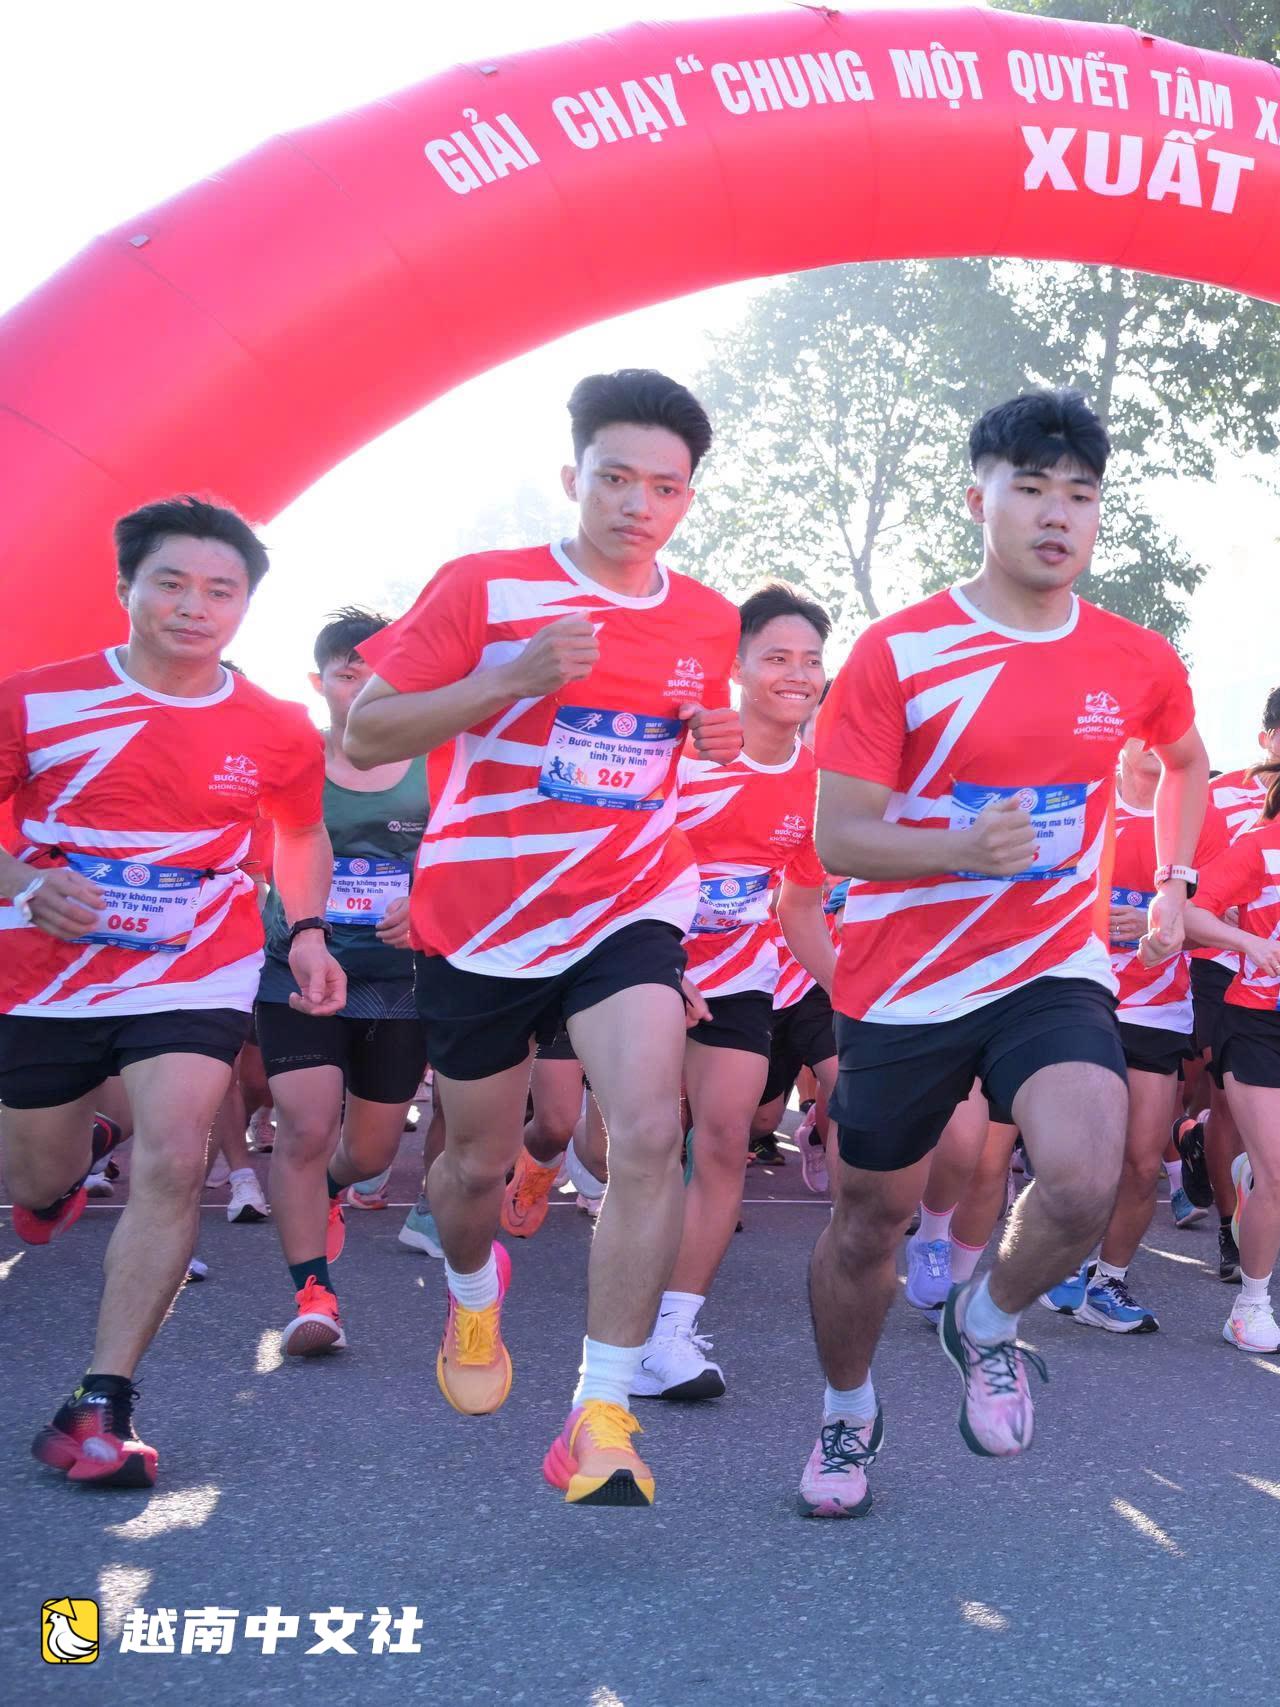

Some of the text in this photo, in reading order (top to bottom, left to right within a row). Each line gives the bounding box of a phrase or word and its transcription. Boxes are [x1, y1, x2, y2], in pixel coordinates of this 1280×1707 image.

[424, 108, 541, 194] GIẢI
[552, 73, 687, 150] CHẠY
[889, 41, 984, 109] MỘT
[1007, 50, 1129, 111] QUYẾT
[1150, 67, 1234, 130] TÂM
[1020, 126, 1256, 215] XUẤT
[568, 736, 591, 748] Bước
[594, 741, 615, 753] chạy
[618, 744, 641, 755] không
[590, 751, 647, 766] tỉnh Tây Ninh
[598, 768, 635, 788] 267
[1049, 819, 1061, 827] ma
[1064, 817, 1076, 827] túy
[129, 892, 157, 904] không
[175, 896, 188, 905] túy
[347, 898, 372, 910] 012
[122, 901, 138, 912] Tây
[141, 903, 164, 913] Ninh
[107, 915, 149, 933] 065
